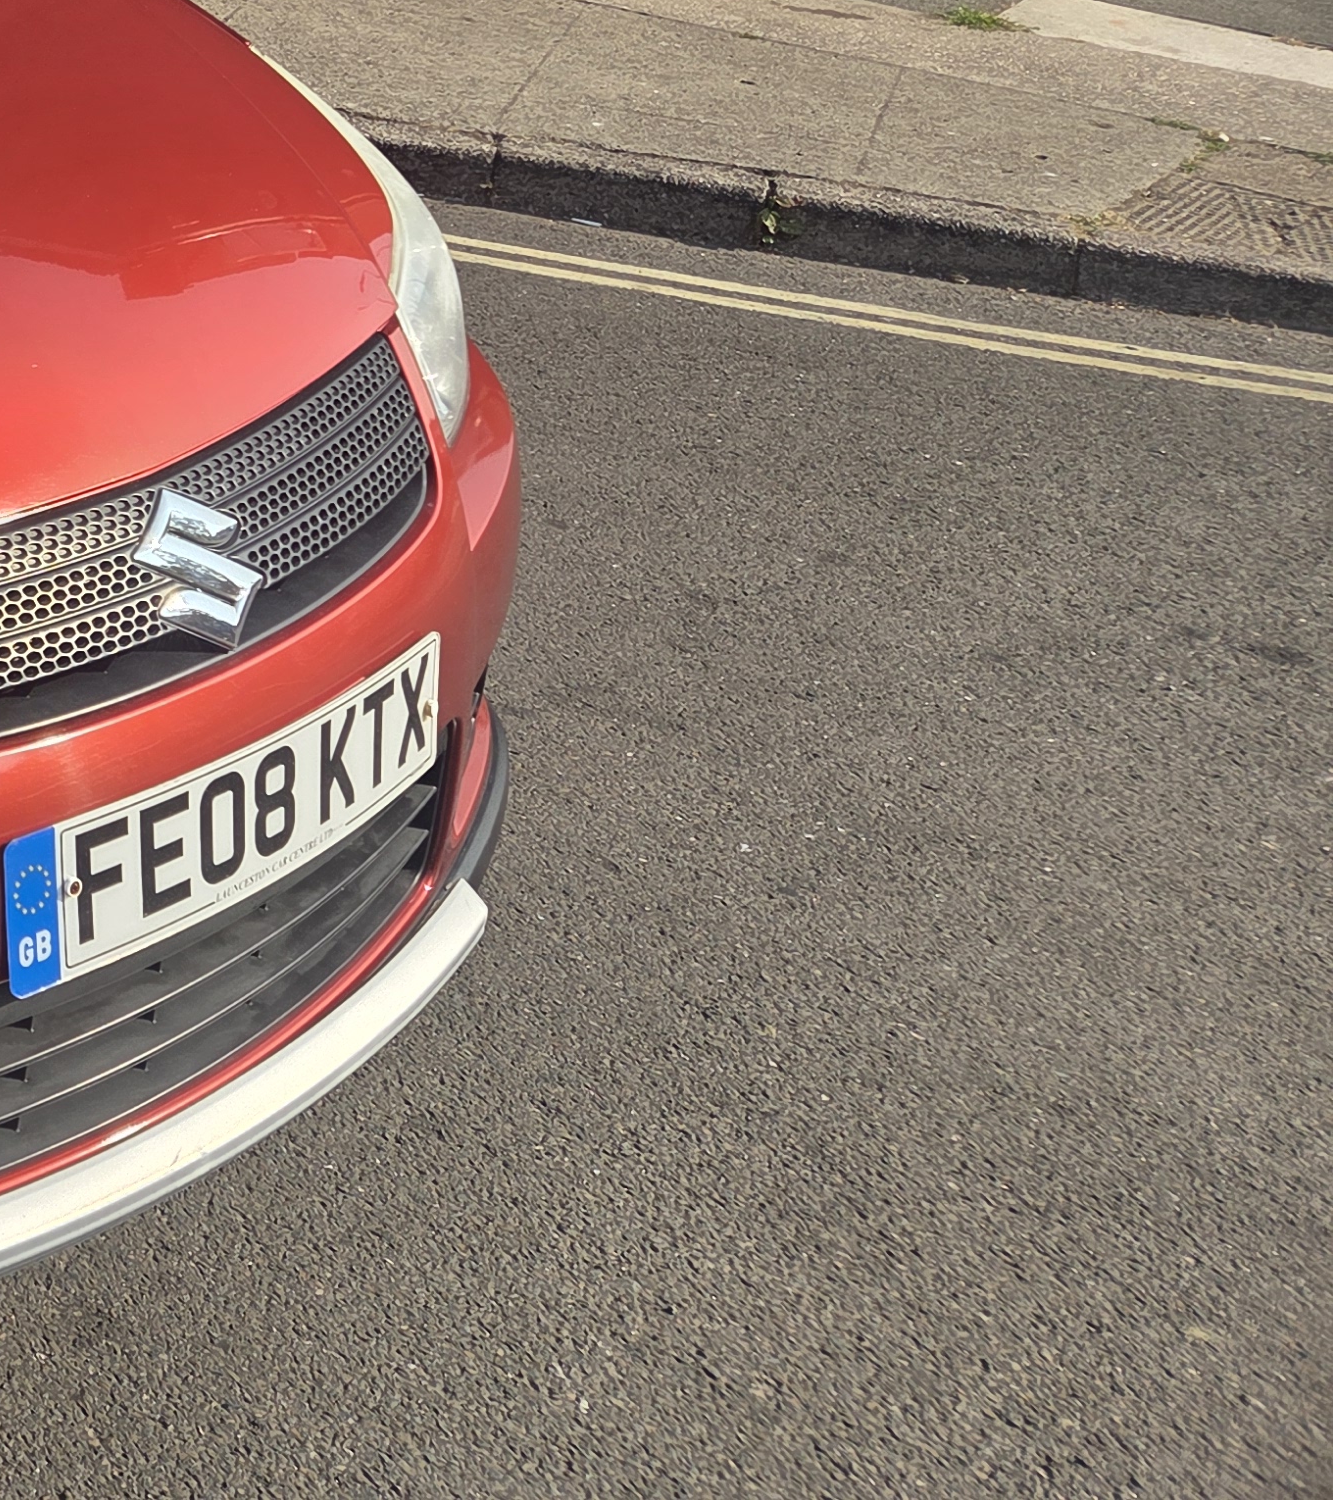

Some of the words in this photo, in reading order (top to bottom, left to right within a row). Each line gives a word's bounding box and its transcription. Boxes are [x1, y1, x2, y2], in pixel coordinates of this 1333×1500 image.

[74, 744, 297, 947] FE08
[319, 653, 430, 826] KTX
[18, 930, 52, 967] GB
